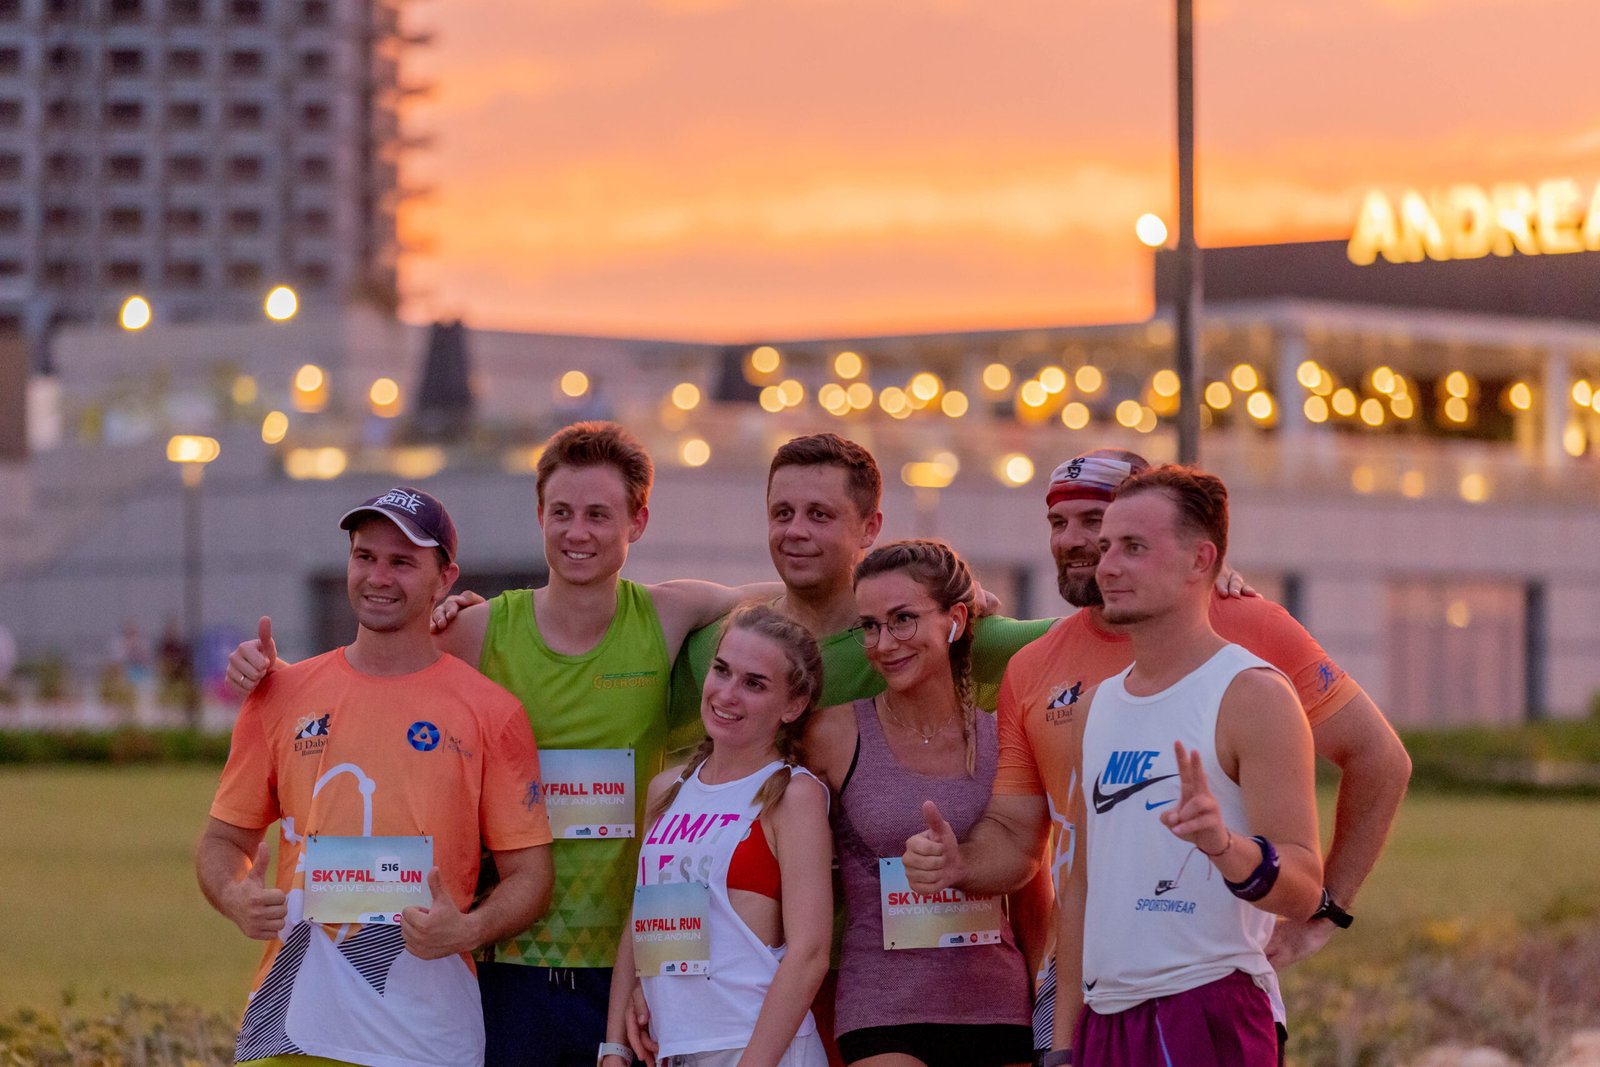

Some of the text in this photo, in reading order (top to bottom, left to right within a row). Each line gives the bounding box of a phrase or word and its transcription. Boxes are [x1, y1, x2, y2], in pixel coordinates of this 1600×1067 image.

[1347, 179, 1600, 266] ANDRE
[1102, 751, 1160, 785] NIKE
[542, 782, 625, 796] YFALL RUN
[599, 796, 625, 805] RUN
[646, 813, 741, 845] LIMIT
[381, 863, 399, 872] 516
[311, 869, 422, 883] SKYFAL UN
[311, 884, 422, 894] SKYDIVE AND RUN
[1158, 880, 1174, 889] NIKE
[888, 889, 961, 905] SKYFALL
[888, 902, 992, 916] SKYDIVE AND RUN
[1135, 898, 1196, 915] SPORTSWEAR
[635, 917, 701, 933] SKYFALL RUN
